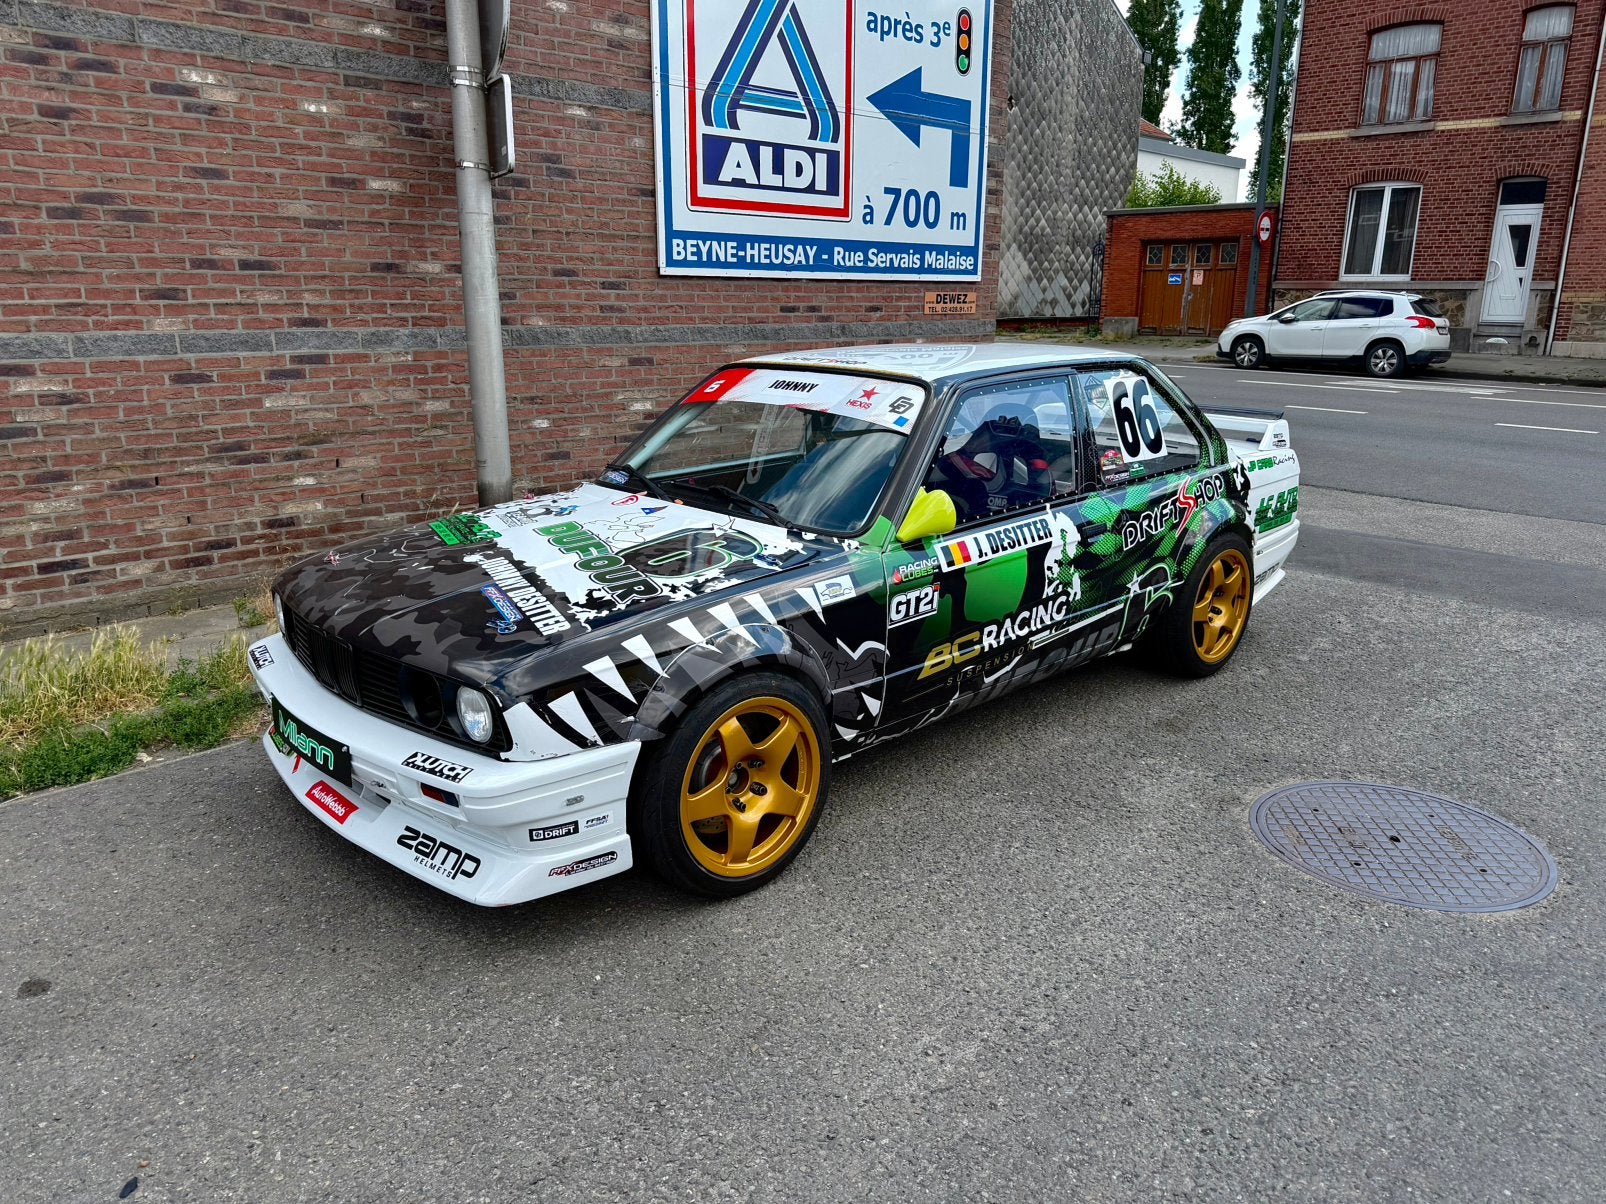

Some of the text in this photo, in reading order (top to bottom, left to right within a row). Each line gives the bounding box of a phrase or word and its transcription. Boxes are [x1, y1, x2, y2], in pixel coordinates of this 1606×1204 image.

[866, 11, 924, 44] après
[717, 141, 828, 192] ALDI
[862, 186, 967, 231] à 700 m
[671, 238, 817, 265] BEYNE-HEUSAY
[833, 246, 863, 268] Rue
[867, 248, 921, 270] Servais
[924, 249, 975, 271] Malaise
[935, 293, 968, 305] DEWEZ
[768, 379, 820, 394] JOHNNY
[845, 398, 873, 411] HEXIS
[1112, 378, 1164, 459] 66
[987, 496, 1008, 507] OMP
[972, 518, 1054, 559] J. DESITTER
[532, 520, 664, 606] DUFOUR
[898, 556, 938, 575] RACING
[901, 567, 934, 582] LUBES
[475, 556, 531, 590] JOHNNY
[505, 586, 573, 636] DESITTER
[916, 595, 1068, 682] BC RACING
[946, 643, 1035, 687] SUSPENSION
[406, 751, 473, 781] KLUTCH
[544, 825, 575, 839] DRIFT
[396, 824, 482, 881] zamp
[413, 855, 454, 879] HELMETS
